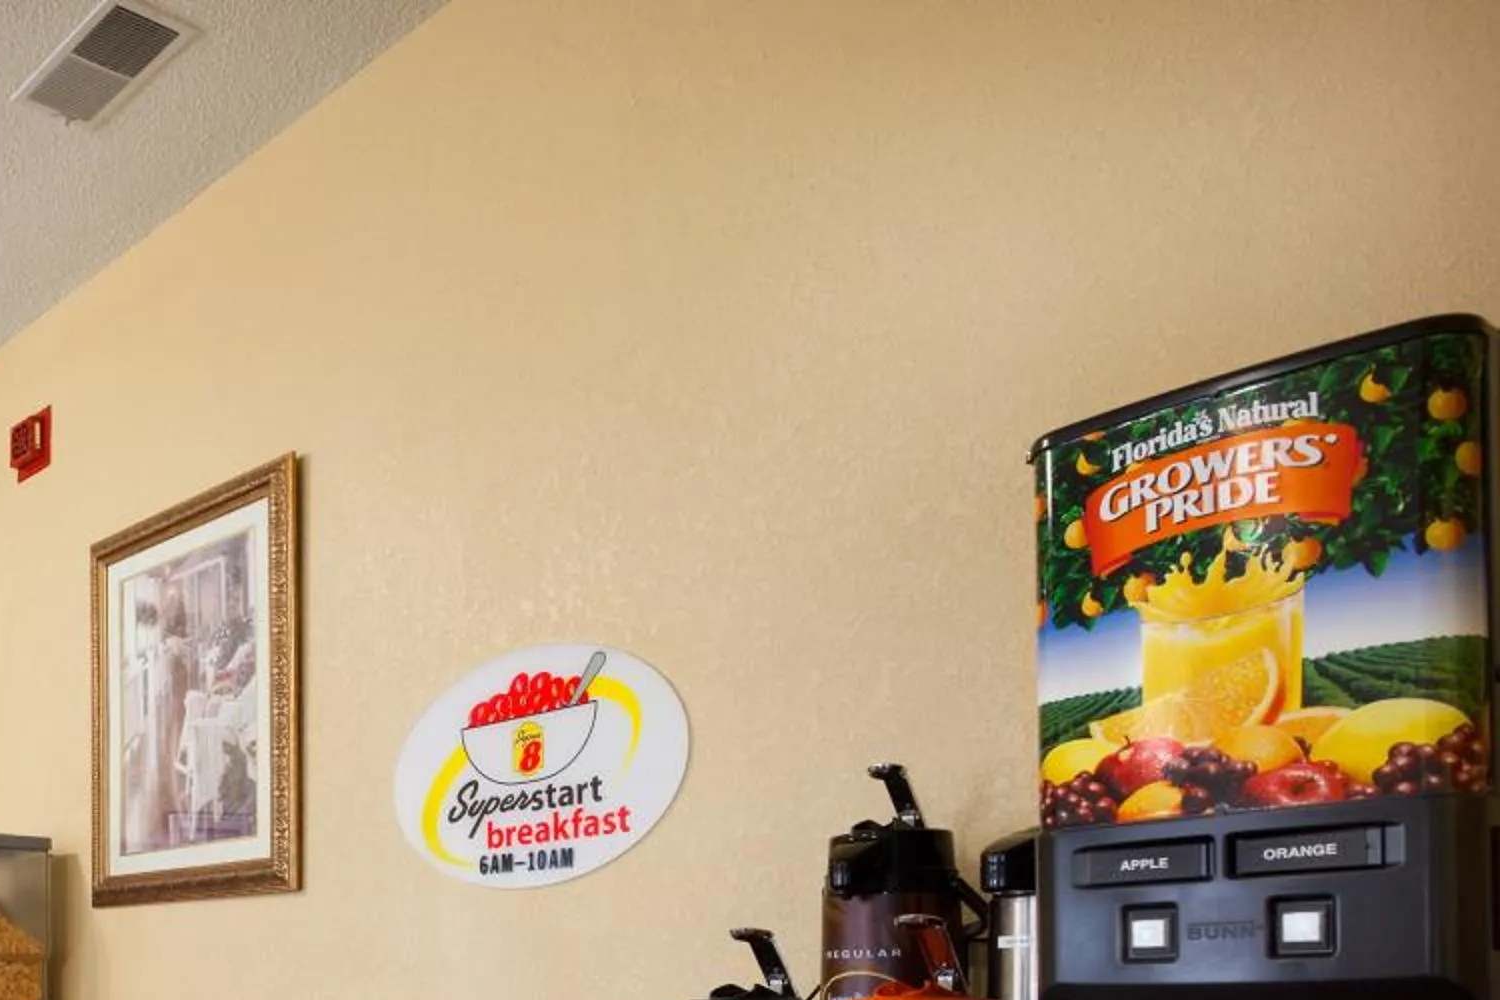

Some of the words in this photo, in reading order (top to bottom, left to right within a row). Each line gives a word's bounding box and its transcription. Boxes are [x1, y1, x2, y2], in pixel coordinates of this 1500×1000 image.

[1109, 411, 1214, 473] Florida's
[1217, 391, 1320, 433] Natural
[1145, 471, 1282, 533] PRIDE
[520, 741, 541, 772] 8
[487, 806, 631, 849] breakfast
[1119, 856, 1170, 872] APPLE
[1262, 842, 1339, 861] ORANGE
[1186, 921, 1256, 941] BUNN
[826, 947, 902, 960] REGULAR
